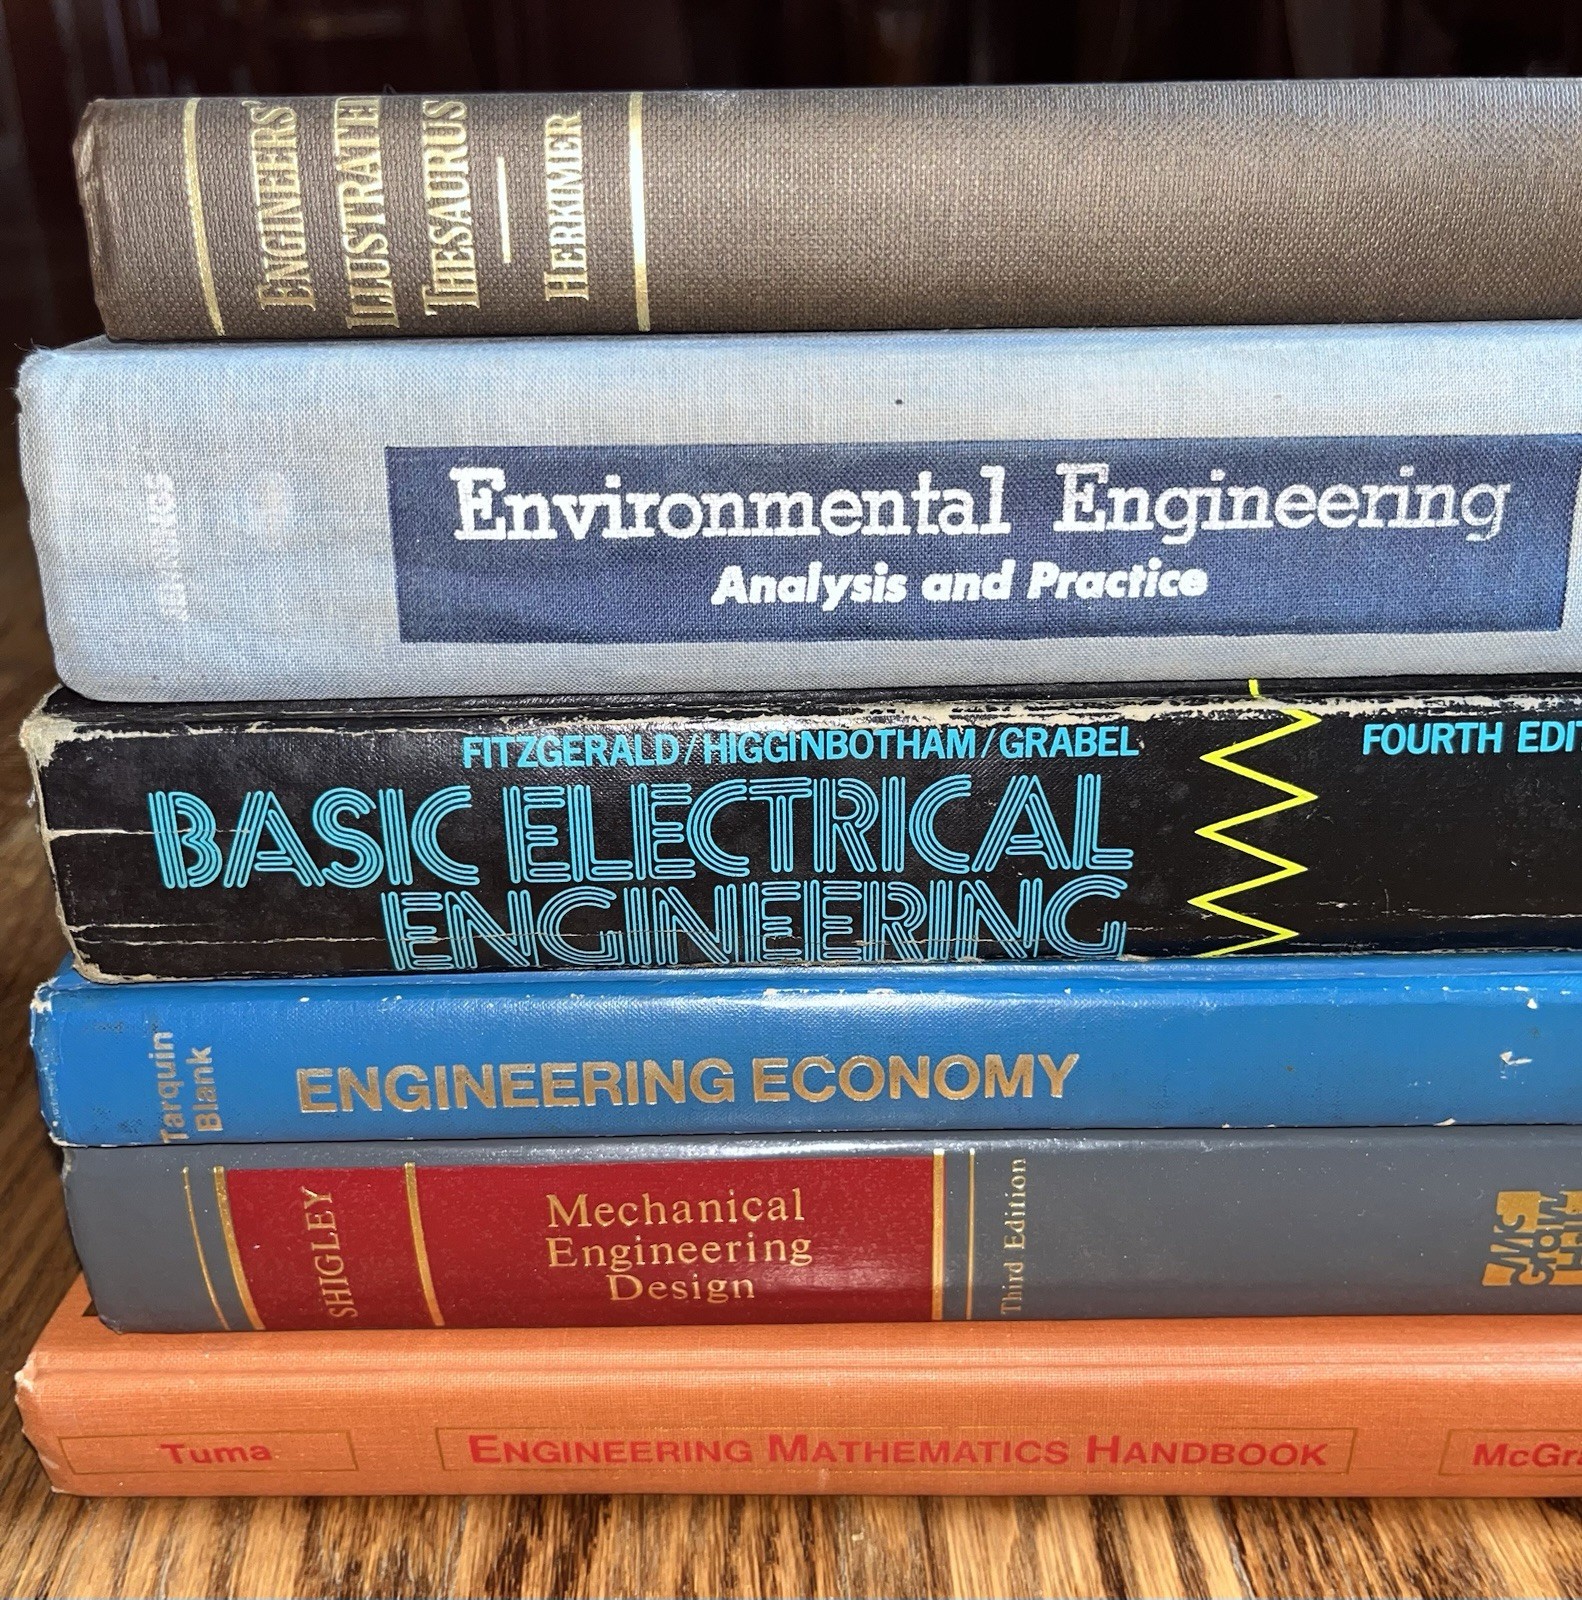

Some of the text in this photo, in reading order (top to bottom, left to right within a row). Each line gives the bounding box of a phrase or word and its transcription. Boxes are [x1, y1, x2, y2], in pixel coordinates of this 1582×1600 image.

[421, 99, 480, 316] THESAURUS
[543, 110, 589, 301] HERKIMER
[450, 462, 1511, 545] Environmental Engineering
[711, 557, 1209, 612] Analysis and Practice
[1362, 720, 1582, 756] FOURTH EDI
[148, 773, 1135, 890] BASIC ELECTRICAL
[380, 874, 1129, 972] ENGINEERING
[149, 1030, 191, 1144] Tarquin
[186, 1045, 224, 1133] Blank
[296, 1053, 1080, 1113] ENGINEERING ECONOMY
[546, 1188, 806, 1229] Mechanical
[1001, 1158, 1027, 1315] Third Edition
[301, 1186, 358, 1319] SHIGLEY
[545, 1234, 813, 1272] Engineering
[605, 1273, 757, 1304] Design
[161, 1442, 272, 1465] Tuma
[469, 1434, 1328, 1466] ENGINEERING MATHEMATICS HANDBOOK
[1472, 1442, 1582, 1467] McGr
